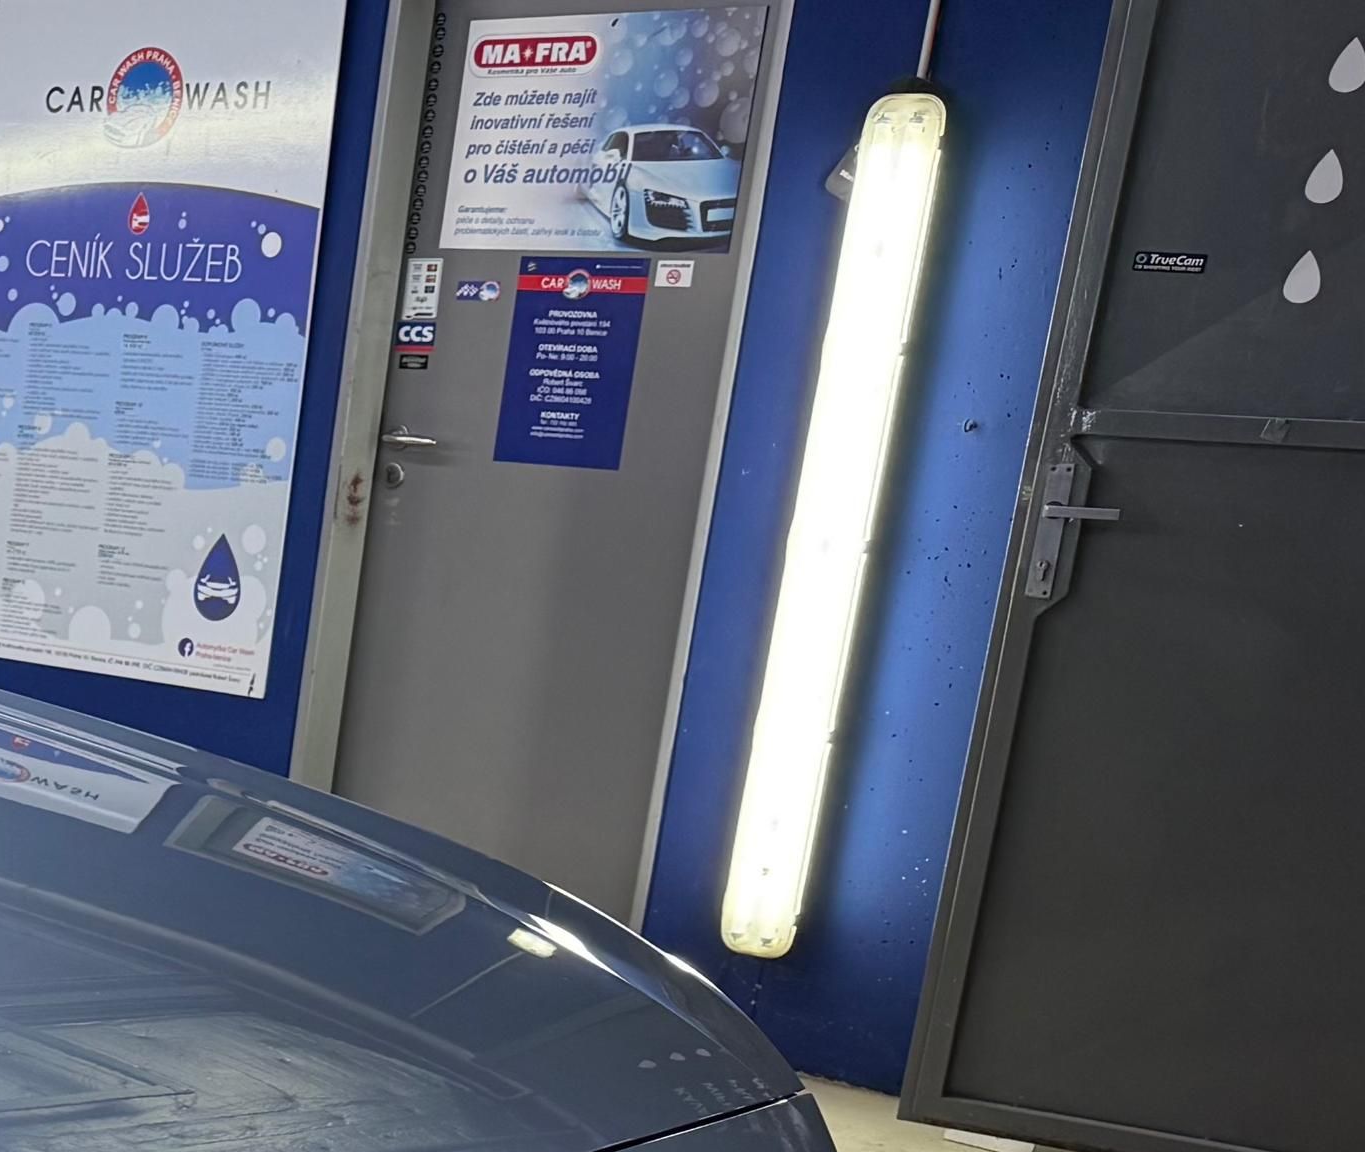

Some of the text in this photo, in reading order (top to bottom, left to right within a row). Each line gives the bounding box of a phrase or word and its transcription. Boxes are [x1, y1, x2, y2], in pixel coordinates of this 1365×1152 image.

[45, 80, 272, 114] CAR WASH
[472, 91, 502, 107] Zde
[562, 87, 597, 108] najít
[470, 112, 597, 130] inovativní řešení
[465, 138, 597, 159] pro čištění a péči
[463, 161, 633, 185] o Váš automobil
[26, 233, 243, 284] CENÍK SLUŽEB
[1149, 253, 1204, 266] TrueCam
[540, 277, 622, 291] CAR WASH
[398, 325, 434, 342] CCS
